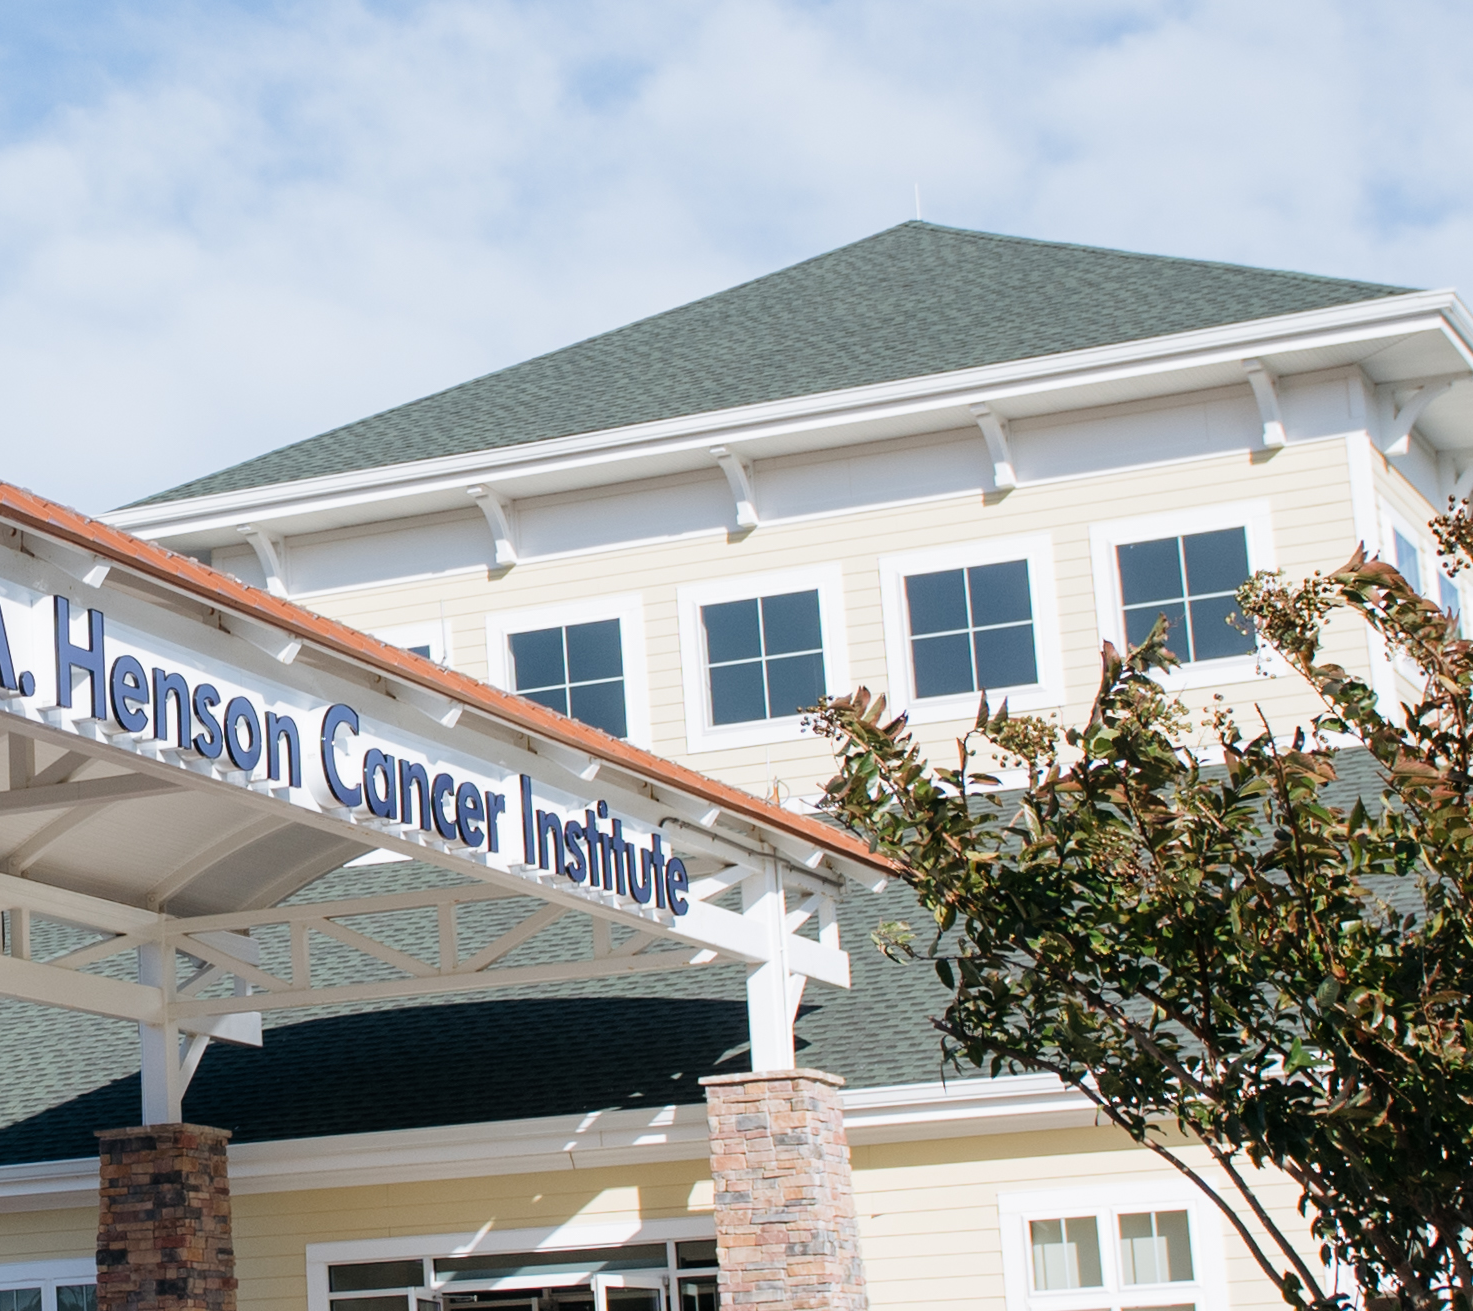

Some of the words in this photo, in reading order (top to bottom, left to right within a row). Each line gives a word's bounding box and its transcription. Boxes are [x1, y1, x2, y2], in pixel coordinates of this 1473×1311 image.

[53, 593, 303, 790] Henson
[320, 703, 507, 858] Cancer
[519, 772, 691, 920] Institute
